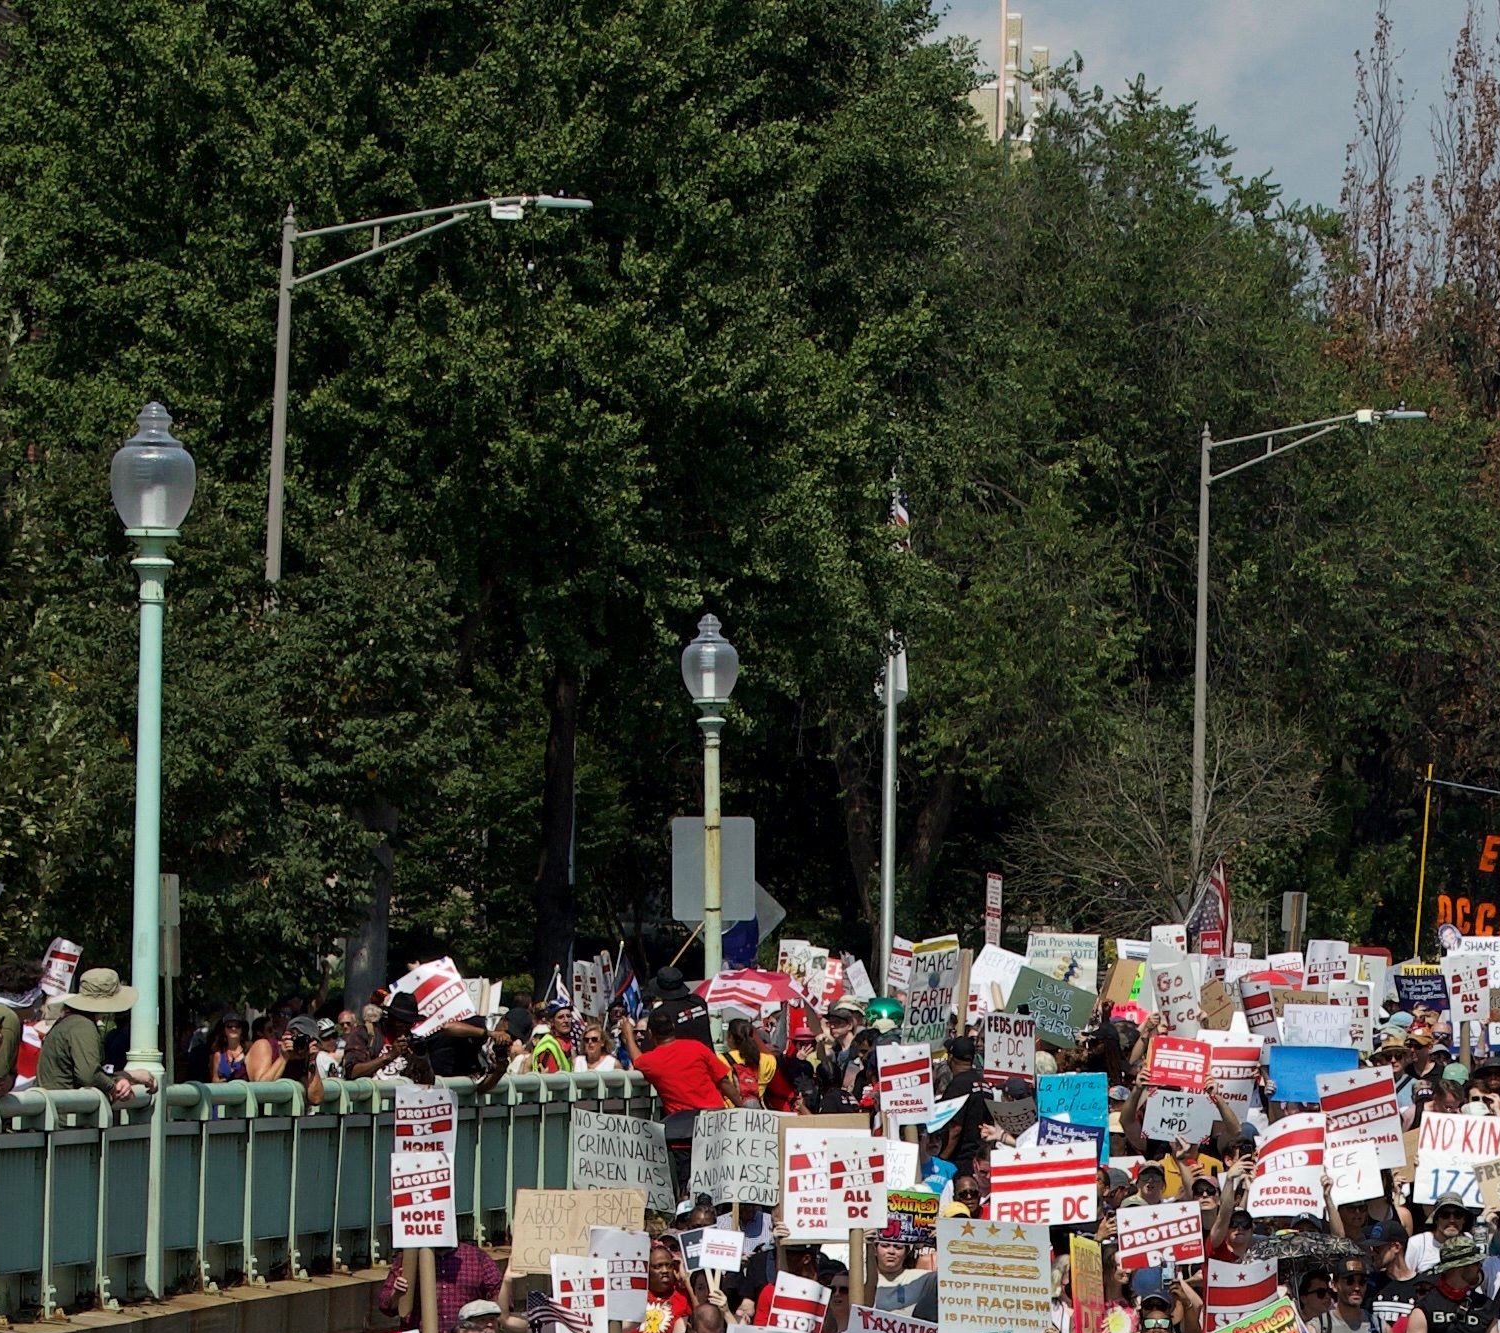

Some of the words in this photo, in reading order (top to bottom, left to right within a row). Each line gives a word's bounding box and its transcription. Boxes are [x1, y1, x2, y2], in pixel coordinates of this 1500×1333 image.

[914, 954, 953, 971] MAKE
[910, 991, 953, 1008] EARTH
[909, 1006, 945, 1025] COOL
[906, 1022, 947, 1041] AGAIN
[988, 1016, 1011, 1035] FEDS
[1013, 1020, 1036, 1038] OUT
[992, 1038, 1003, 1053] of
[575, 1110, 591, 1129] NO
[597, 1116, 653, 1137] SOMOS
[393, 1167, 450, 1187] PROTECT
[578, 1159, 626, 1182] PAREN
[637, 1164, 667, 1184] LAS
[411, 1189, 432, 1204] DC
[400, 1210, 445, 1222] HOME
[405, 1224, 442, 1236] RULE
